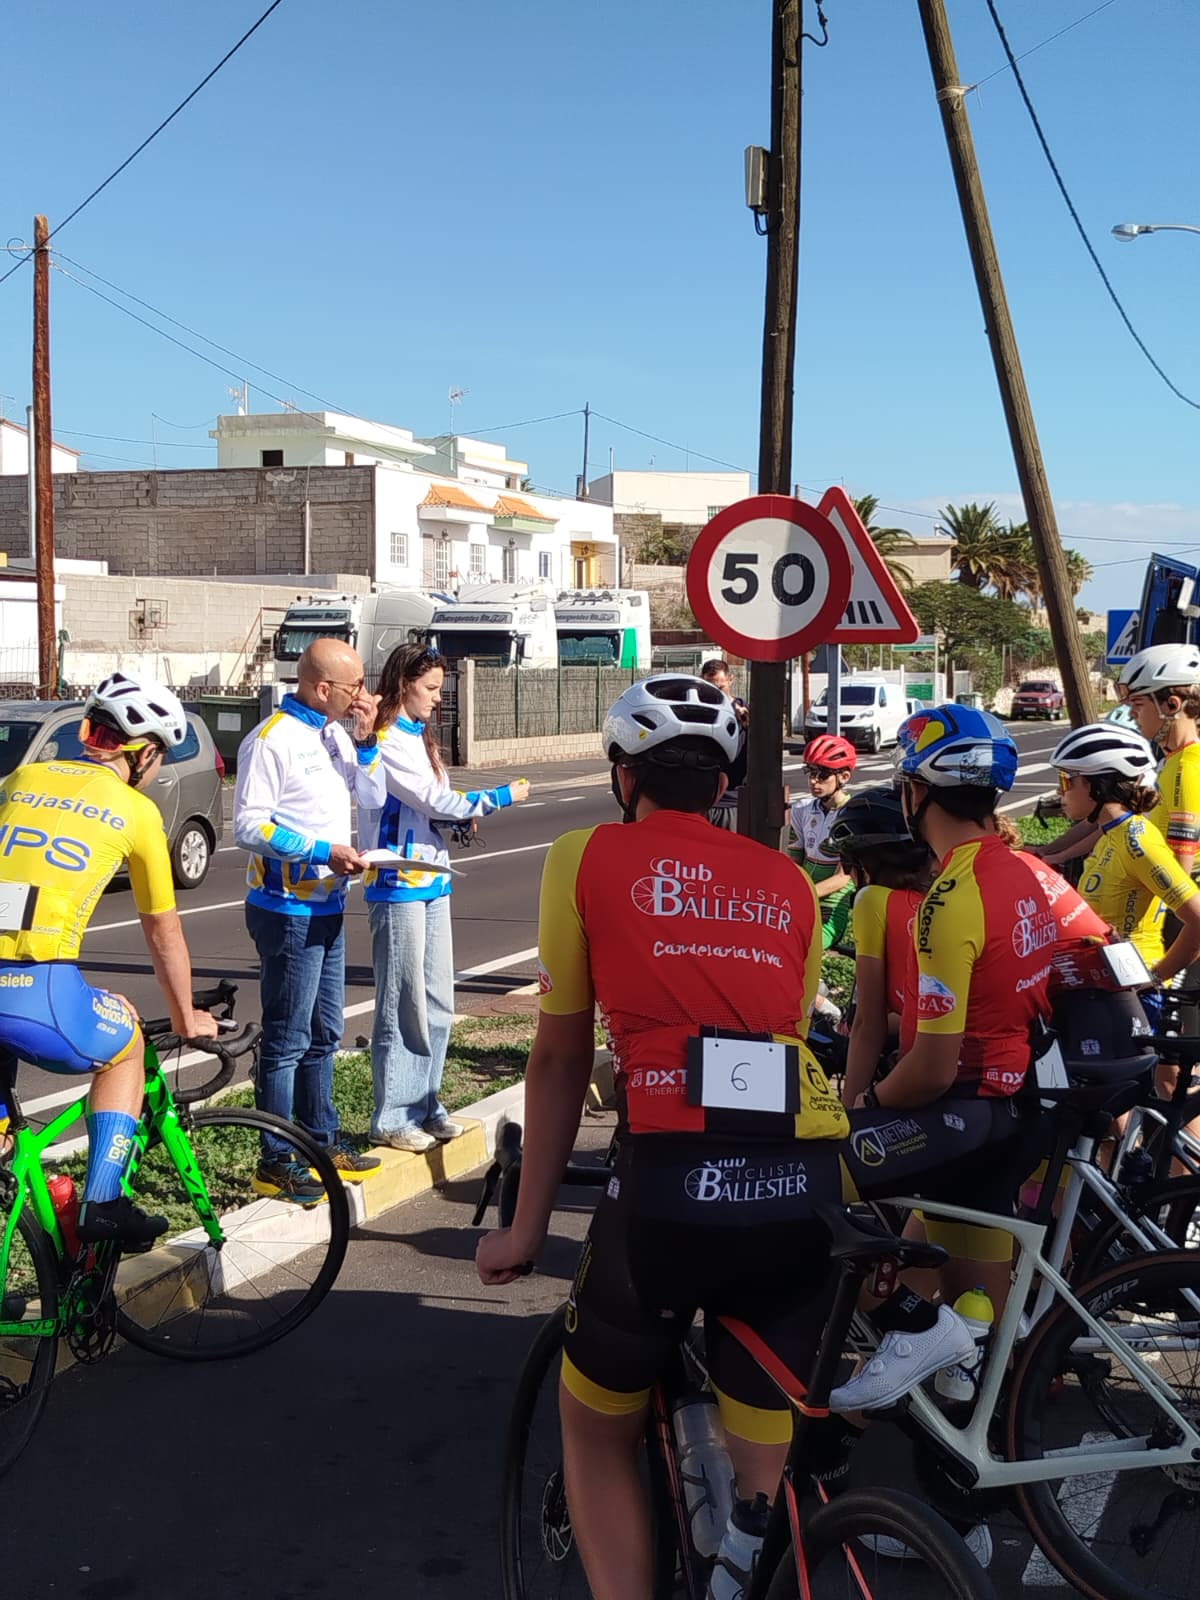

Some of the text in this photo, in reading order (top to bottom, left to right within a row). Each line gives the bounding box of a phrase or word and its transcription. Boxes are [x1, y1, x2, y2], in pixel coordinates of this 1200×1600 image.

[721, 552, 815, 606] 50
[10, 791, 125, 830] cajasiete
[655, 858, 713, 882] Club
[653, 876, 792, 934] BALLESTER
[683, 881, 792, 911] CICLISTA
[919, 878, 956, 954] Dulcesol
[645, 1070, 687, 1086] DXT
[645, 1086, 687, 1096] TENERIFE
[731, 1062, 751, 1091] 6
[698, 1167, 807, 1202] BALLESTER
[722, 1162, 807, 1181] CICLISTA
[1087, 1278, 1140, 1306] ZIPP
